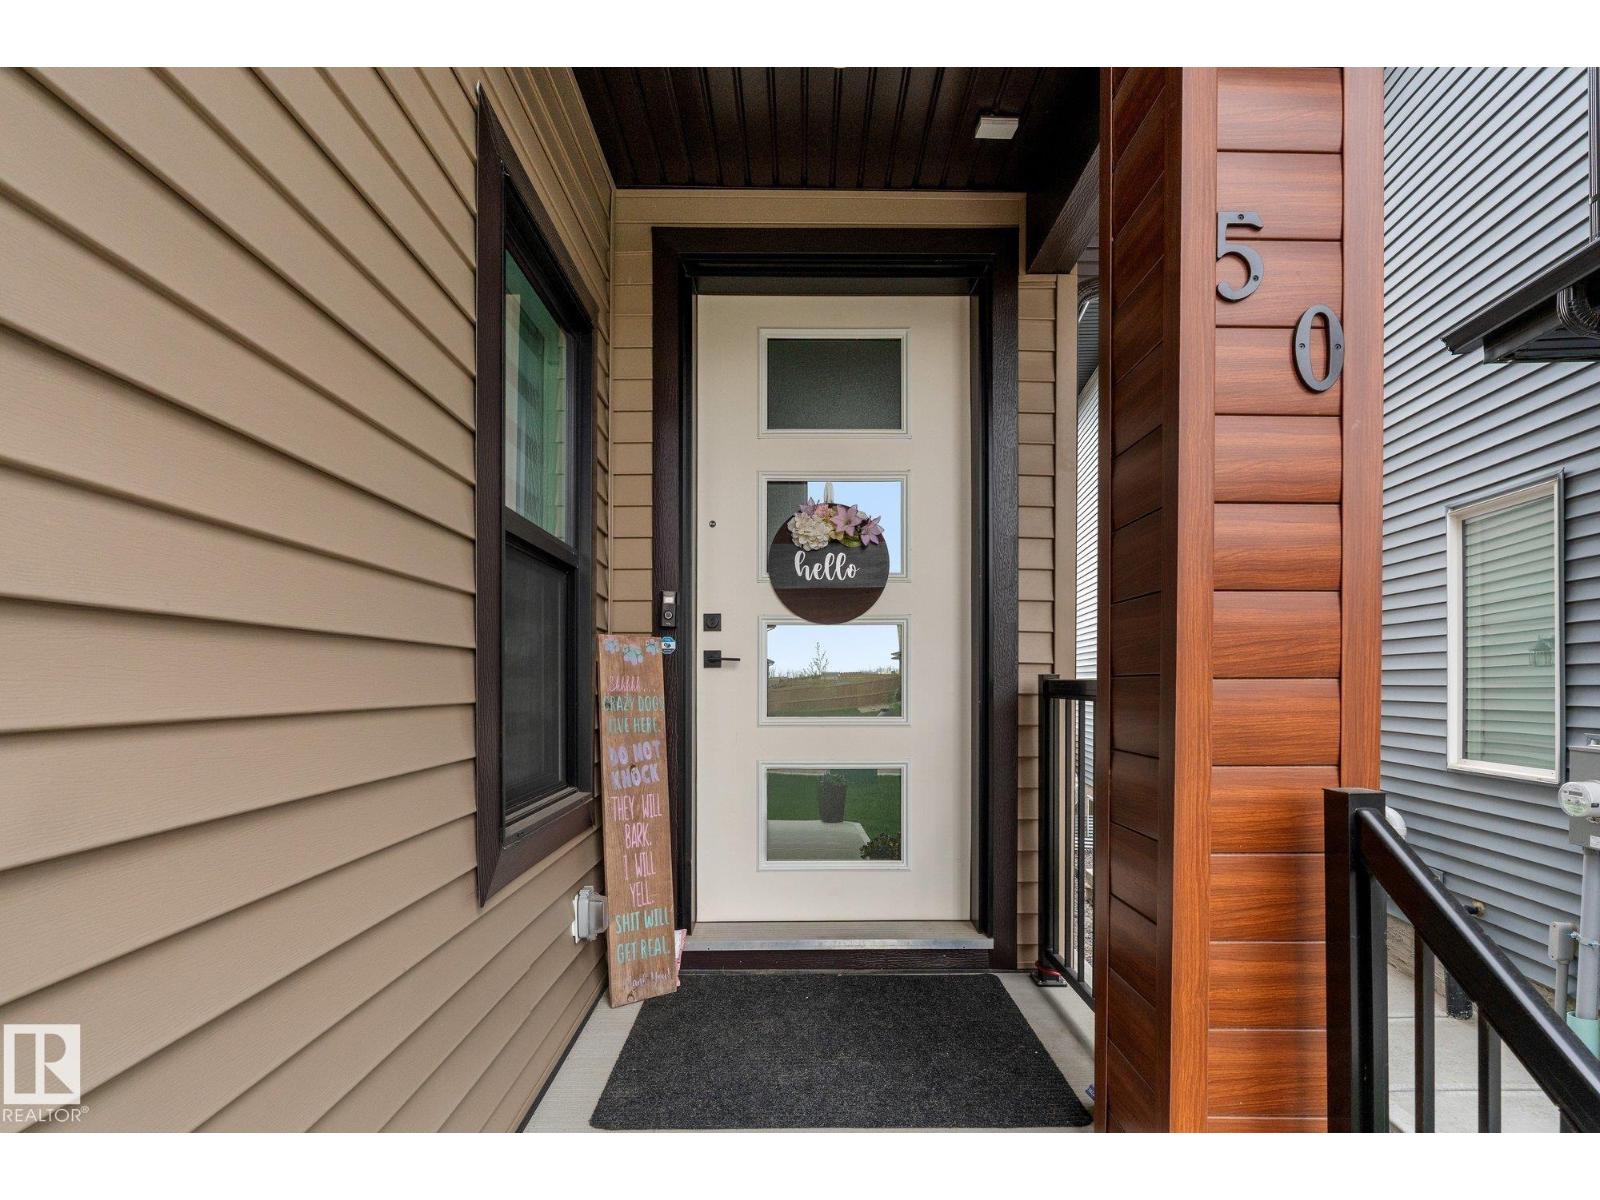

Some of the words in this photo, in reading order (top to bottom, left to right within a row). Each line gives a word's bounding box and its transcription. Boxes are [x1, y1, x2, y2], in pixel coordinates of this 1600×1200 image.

[794, 550, 860, 581] hello
[608, 745, 629, 767] DO
[633, 740, 660, 763] NOT
[611, 763, 660, 790] KNOCK
[608, 794, 635, 821] THEY
[641, 792, 662, 819] WILL
[635, 851, 656, 878] WILL
[615, 911, 640, 935] SHIT
[644, 907, 670, 928] WILL
[617, 941, 637, 965] GET
